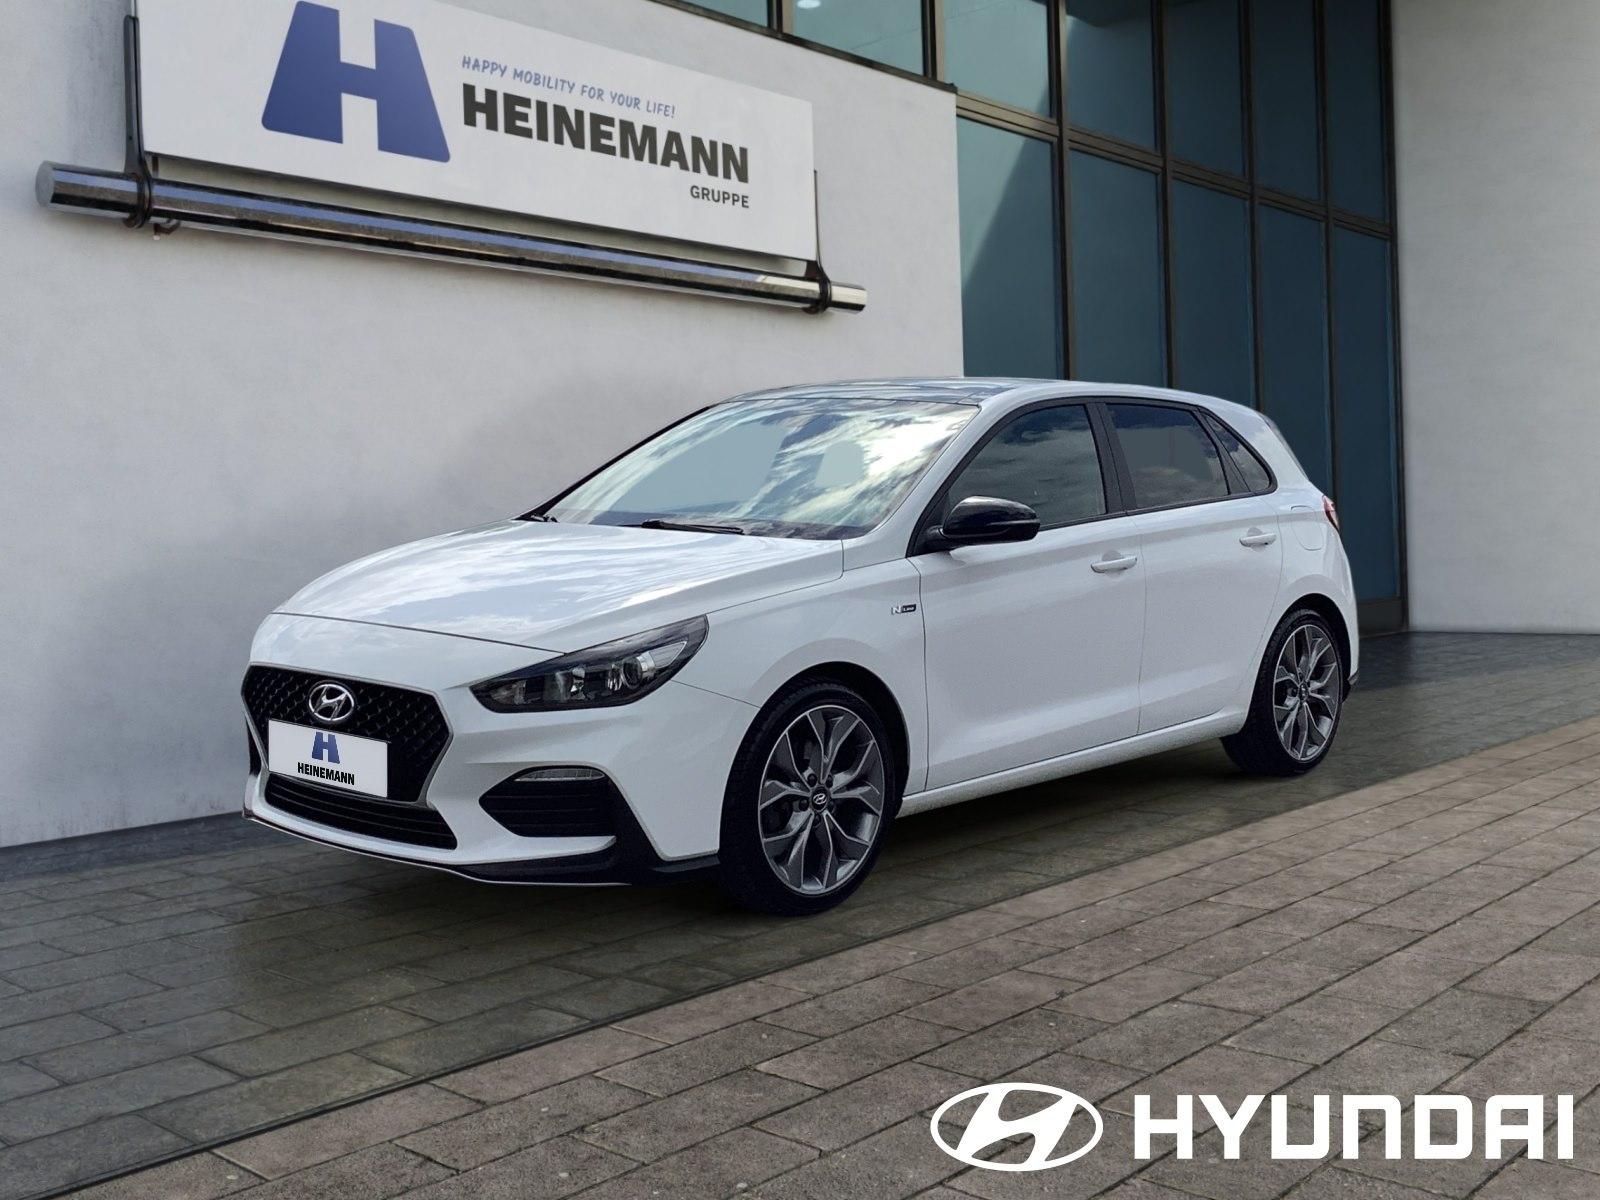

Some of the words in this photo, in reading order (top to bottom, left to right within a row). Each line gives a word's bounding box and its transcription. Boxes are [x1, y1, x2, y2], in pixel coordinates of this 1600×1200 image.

[462, 55, 508, 78] HAPPY
[513, 68, 575, 94] MOBILITY
[580, 84, 605, 101] FOR
[609, 90, 641, 111] YOUR
[646, 100, 676, 119] LIFE!
[462, 82, 749, 184] HEINEMANN
[690, 185, 750, 209] GRUPPE
[297, 762, 355, 786] HEINEMANN
